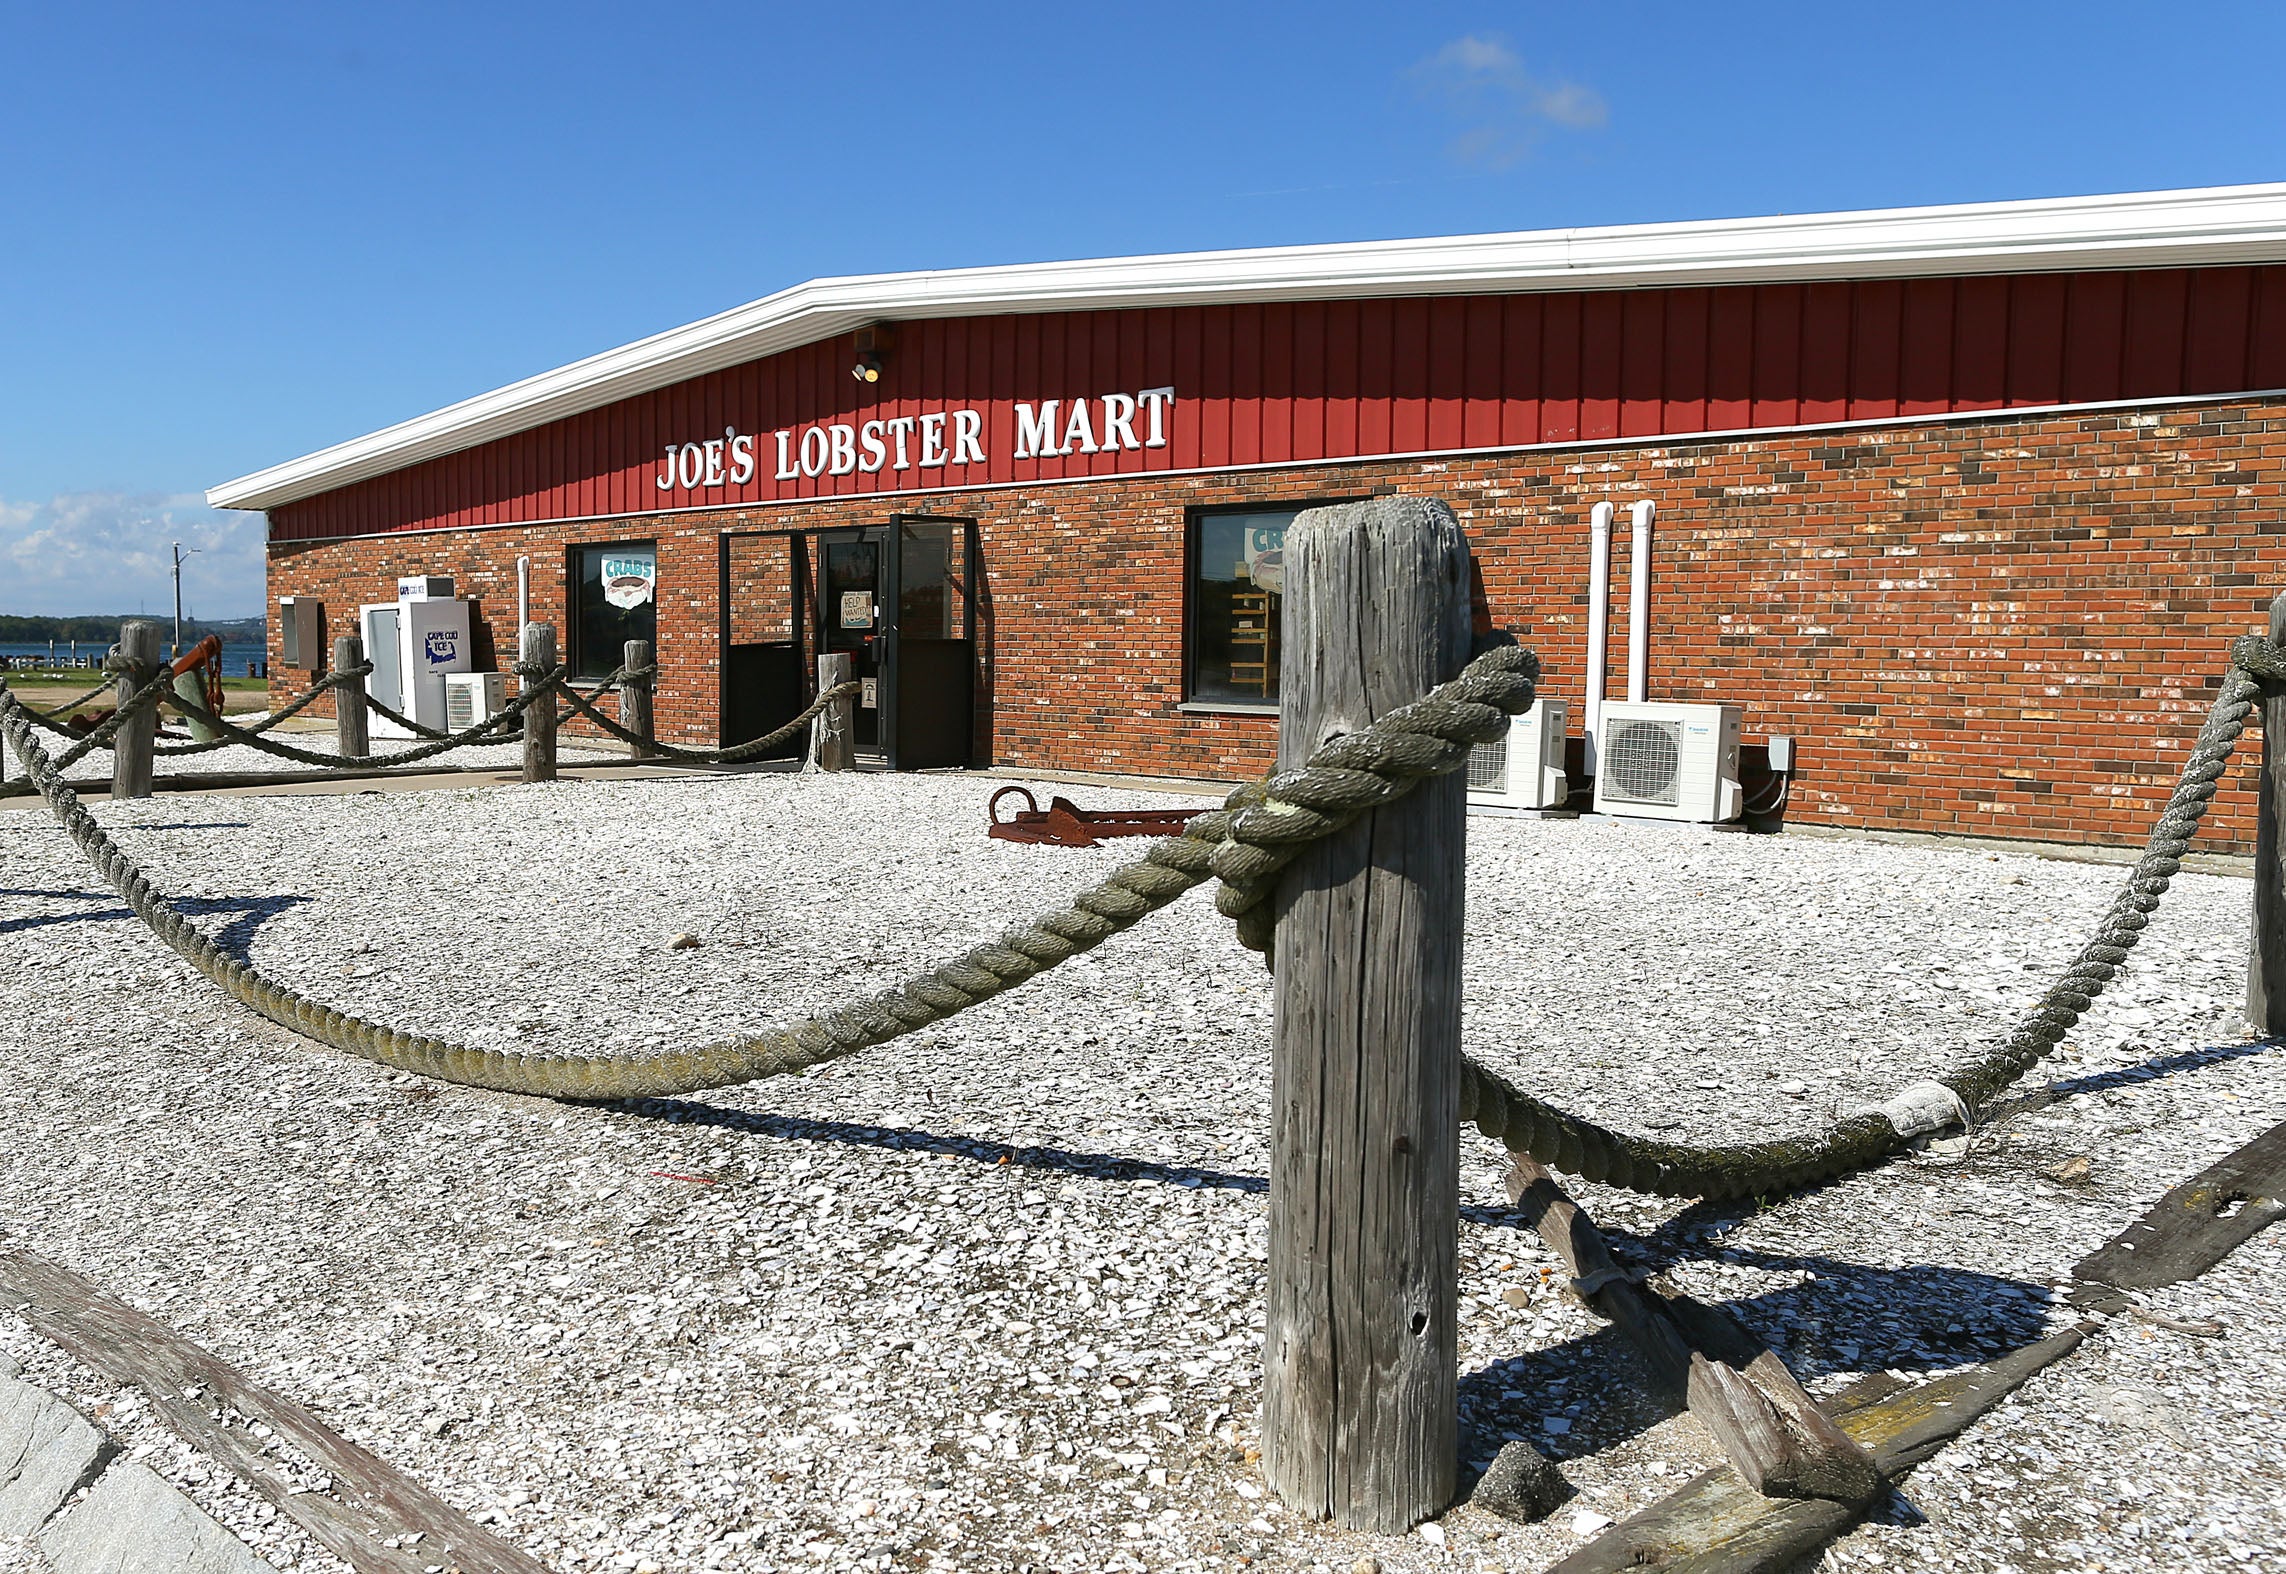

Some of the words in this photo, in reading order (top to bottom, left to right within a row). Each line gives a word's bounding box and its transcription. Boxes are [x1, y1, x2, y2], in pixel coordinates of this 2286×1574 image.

[656, 425, 755, 491] JOE'S
[774, 409, 988, 481] LOBSTER
[1013, 385, 1175, 460] MART
[605, 559, 652, 578] CRABS
[427, 632, 444, 640] CAPE
[434, 641, 447, 651] ICE
